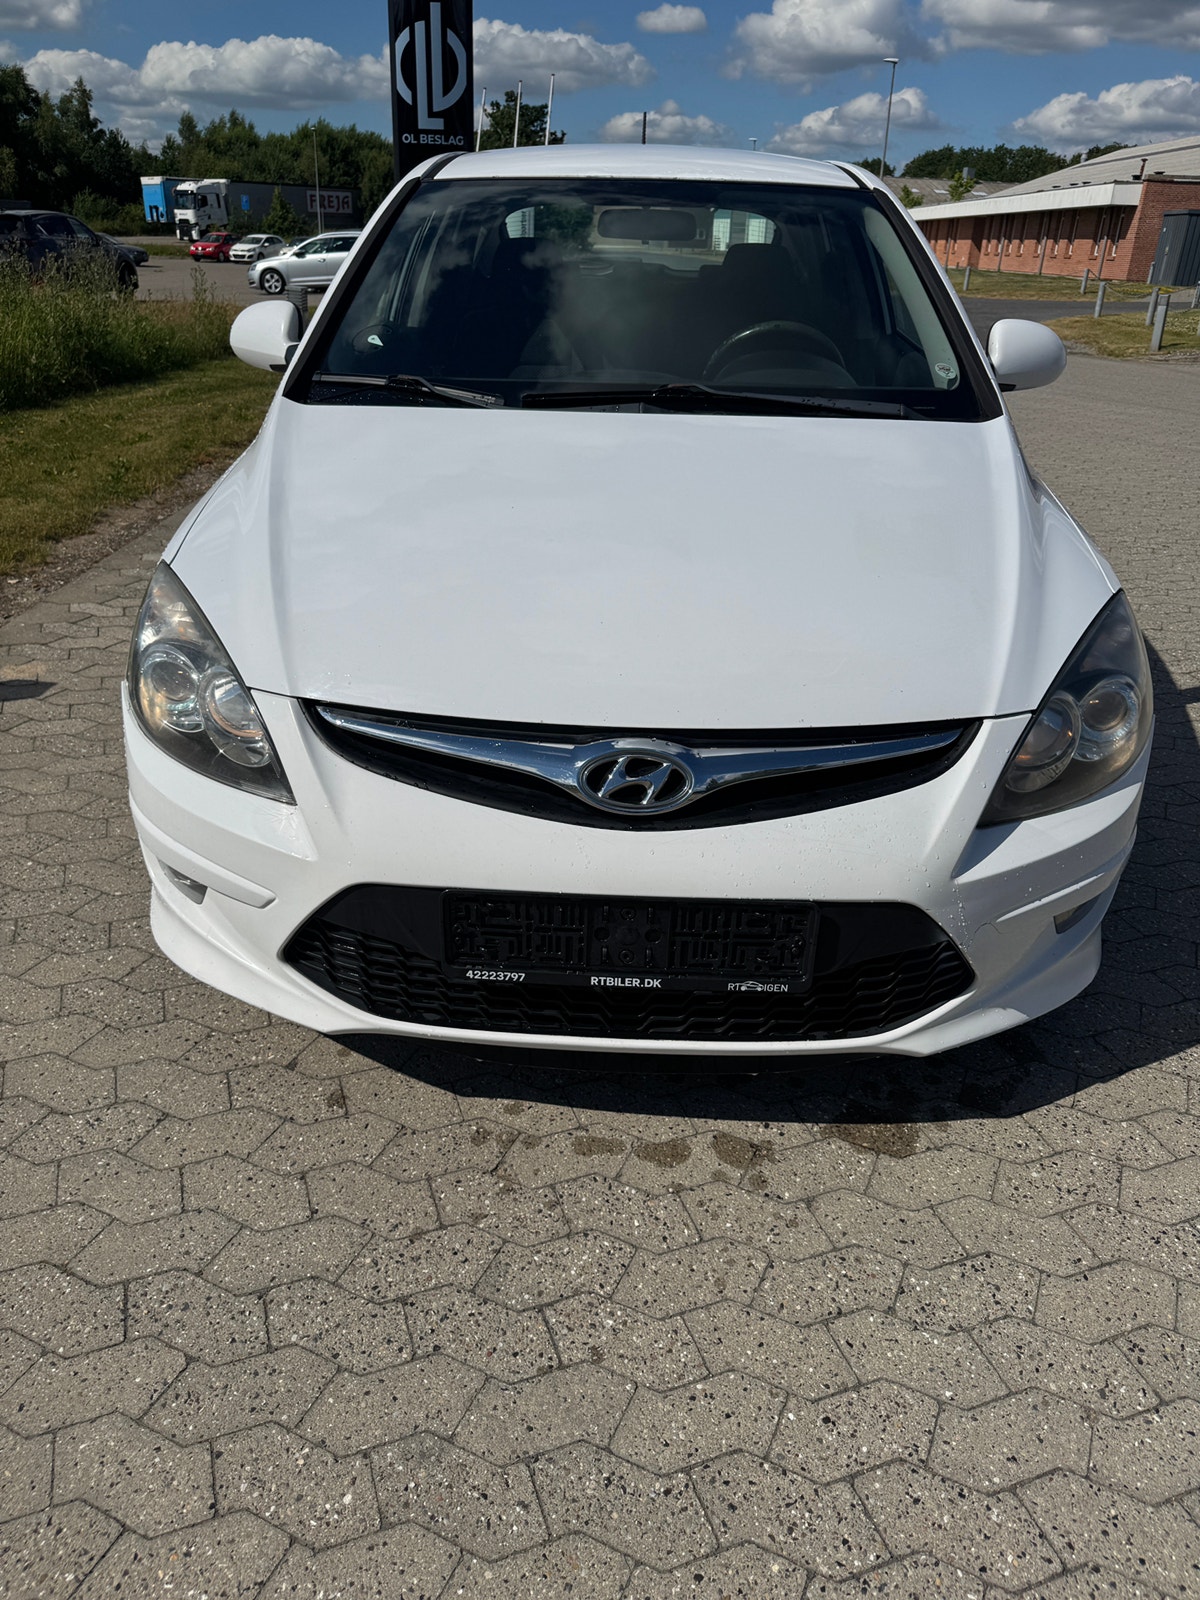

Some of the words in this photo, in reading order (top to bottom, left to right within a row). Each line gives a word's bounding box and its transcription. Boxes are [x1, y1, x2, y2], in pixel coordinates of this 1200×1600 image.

[402, 133, 417, 144] OL
[420, 134, 464, 146] BESLAG
[310, 193, 350, 212] FREJA
[465, 970, 526, 982] 42223797
[590, 976, 662, 988] RTBILER.DK
